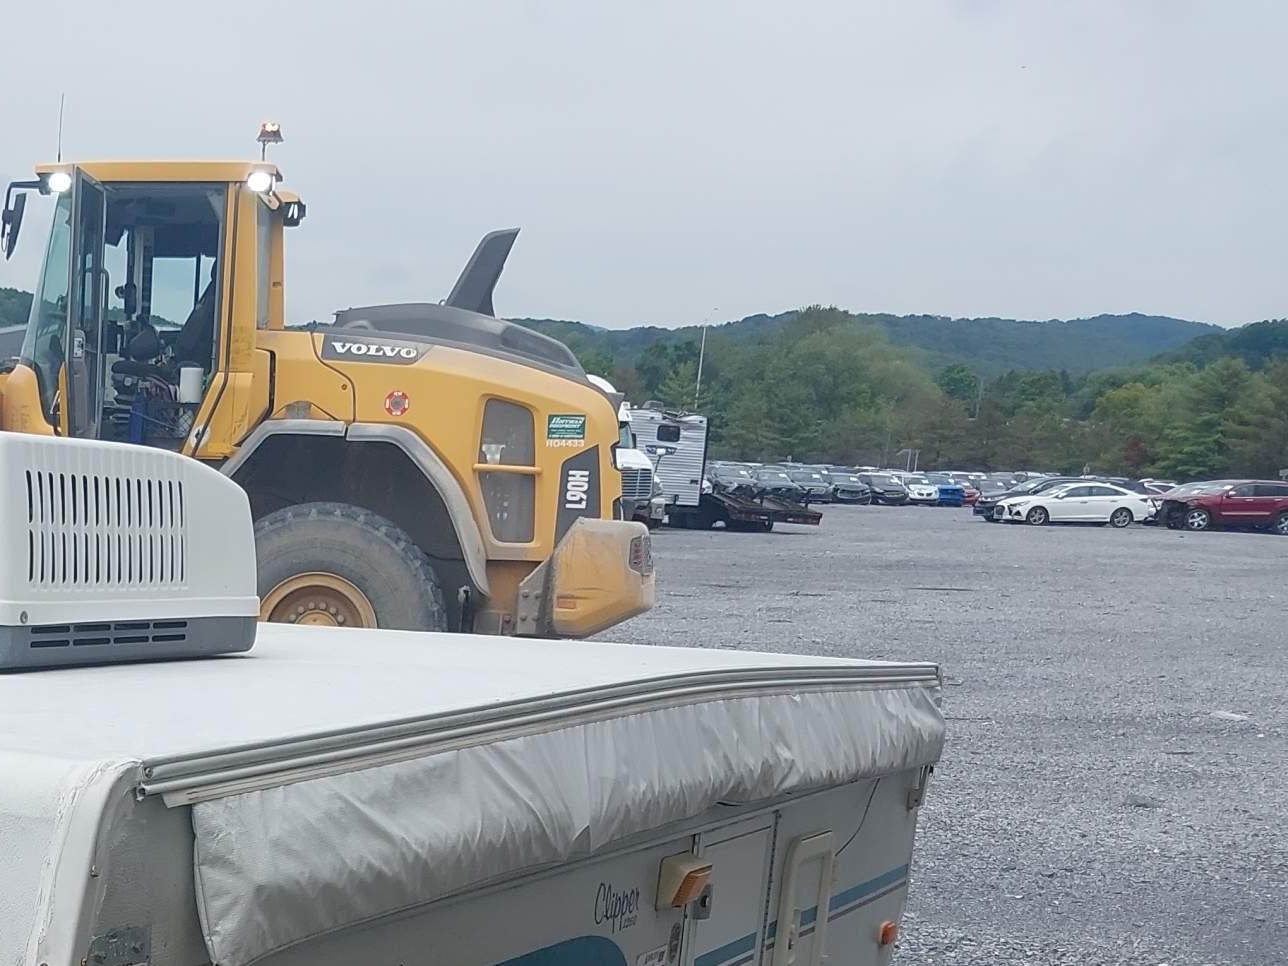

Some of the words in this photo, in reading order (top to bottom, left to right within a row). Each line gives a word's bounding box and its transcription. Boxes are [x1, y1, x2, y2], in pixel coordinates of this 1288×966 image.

[331, 342, 418, 358] VOLVO
[565, 469, 590, 509] L90H
[594, 882, 640, 934] Clipper
